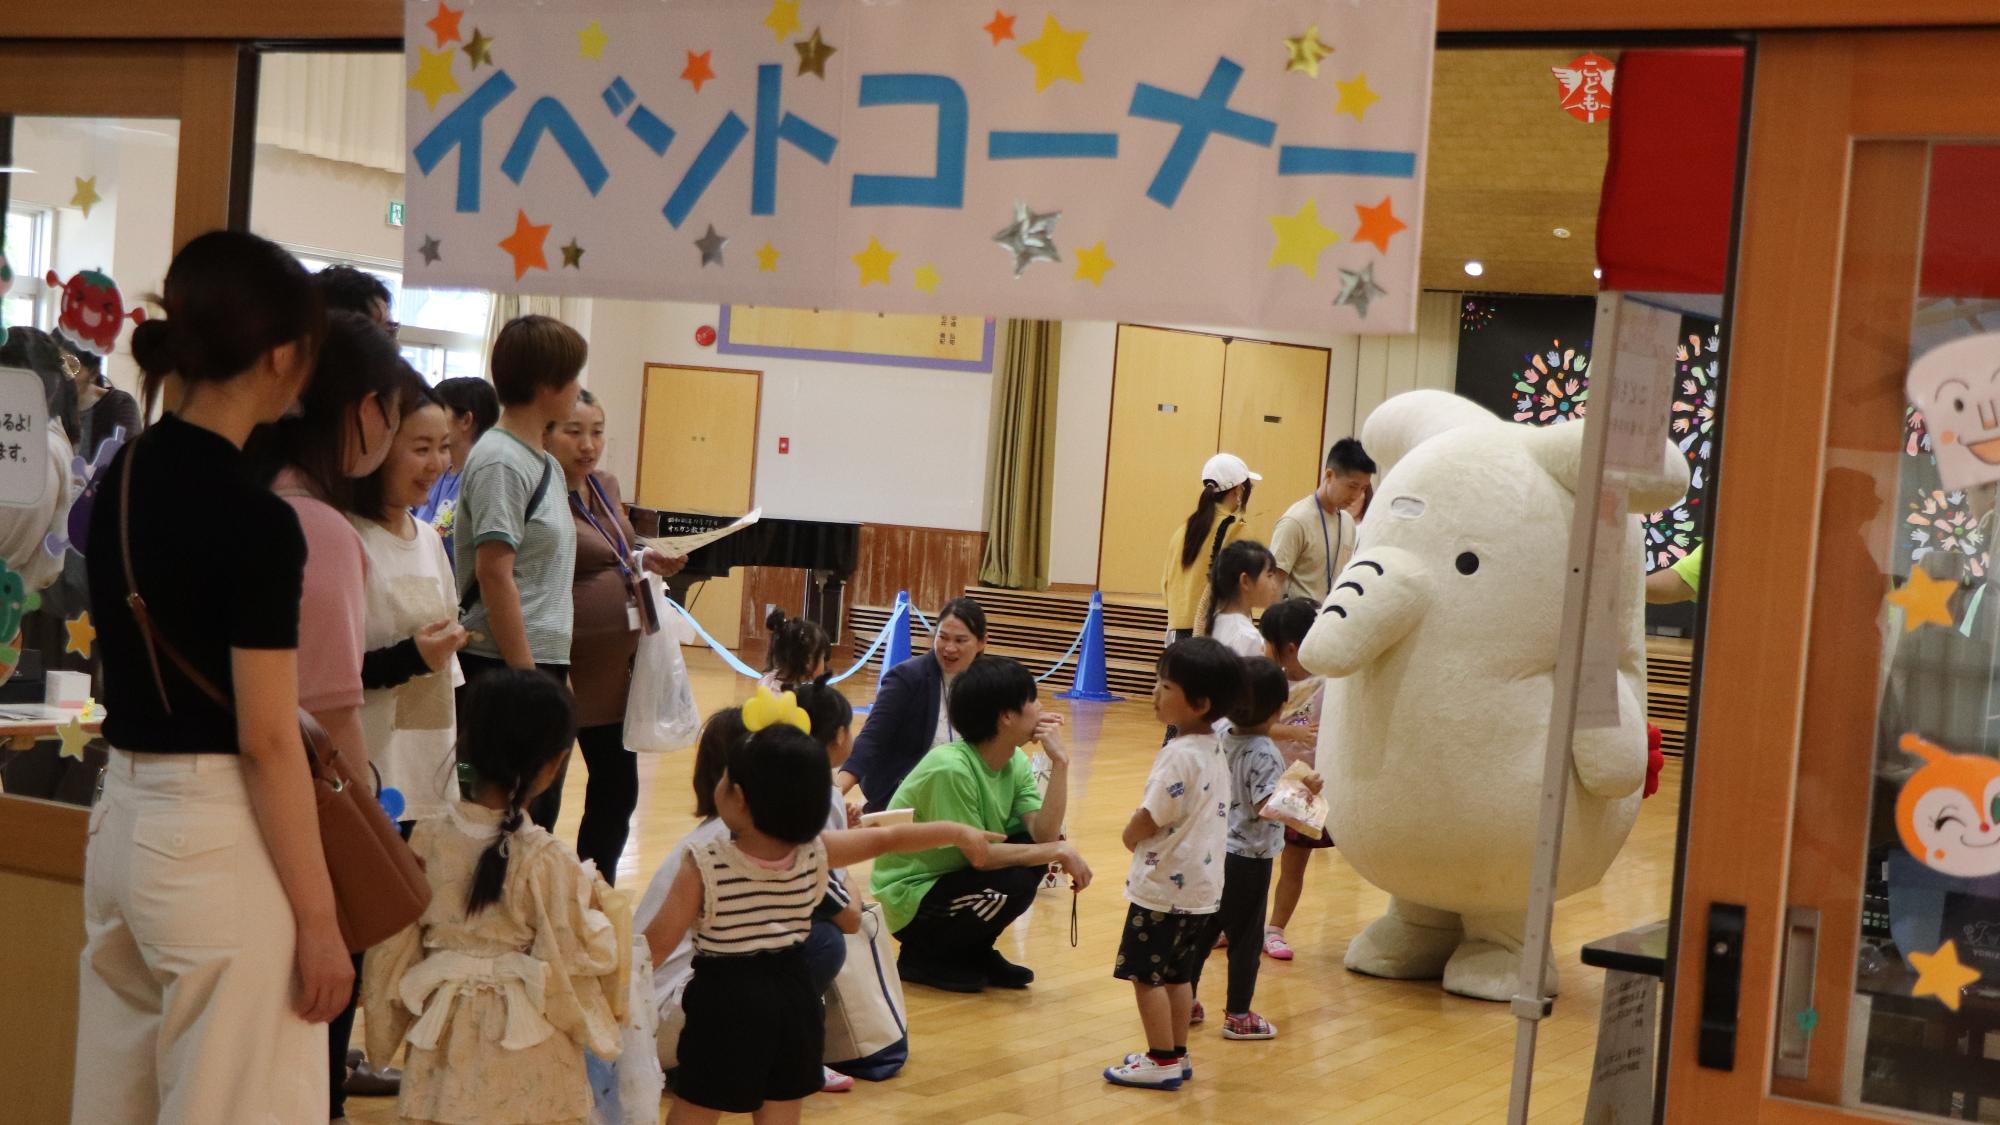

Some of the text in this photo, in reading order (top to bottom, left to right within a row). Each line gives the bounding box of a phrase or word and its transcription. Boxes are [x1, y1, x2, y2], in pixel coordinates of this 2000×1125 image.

[413, 56, 1415, 229] イベントコーナー
[0, 413, 31, 432] るよ!
